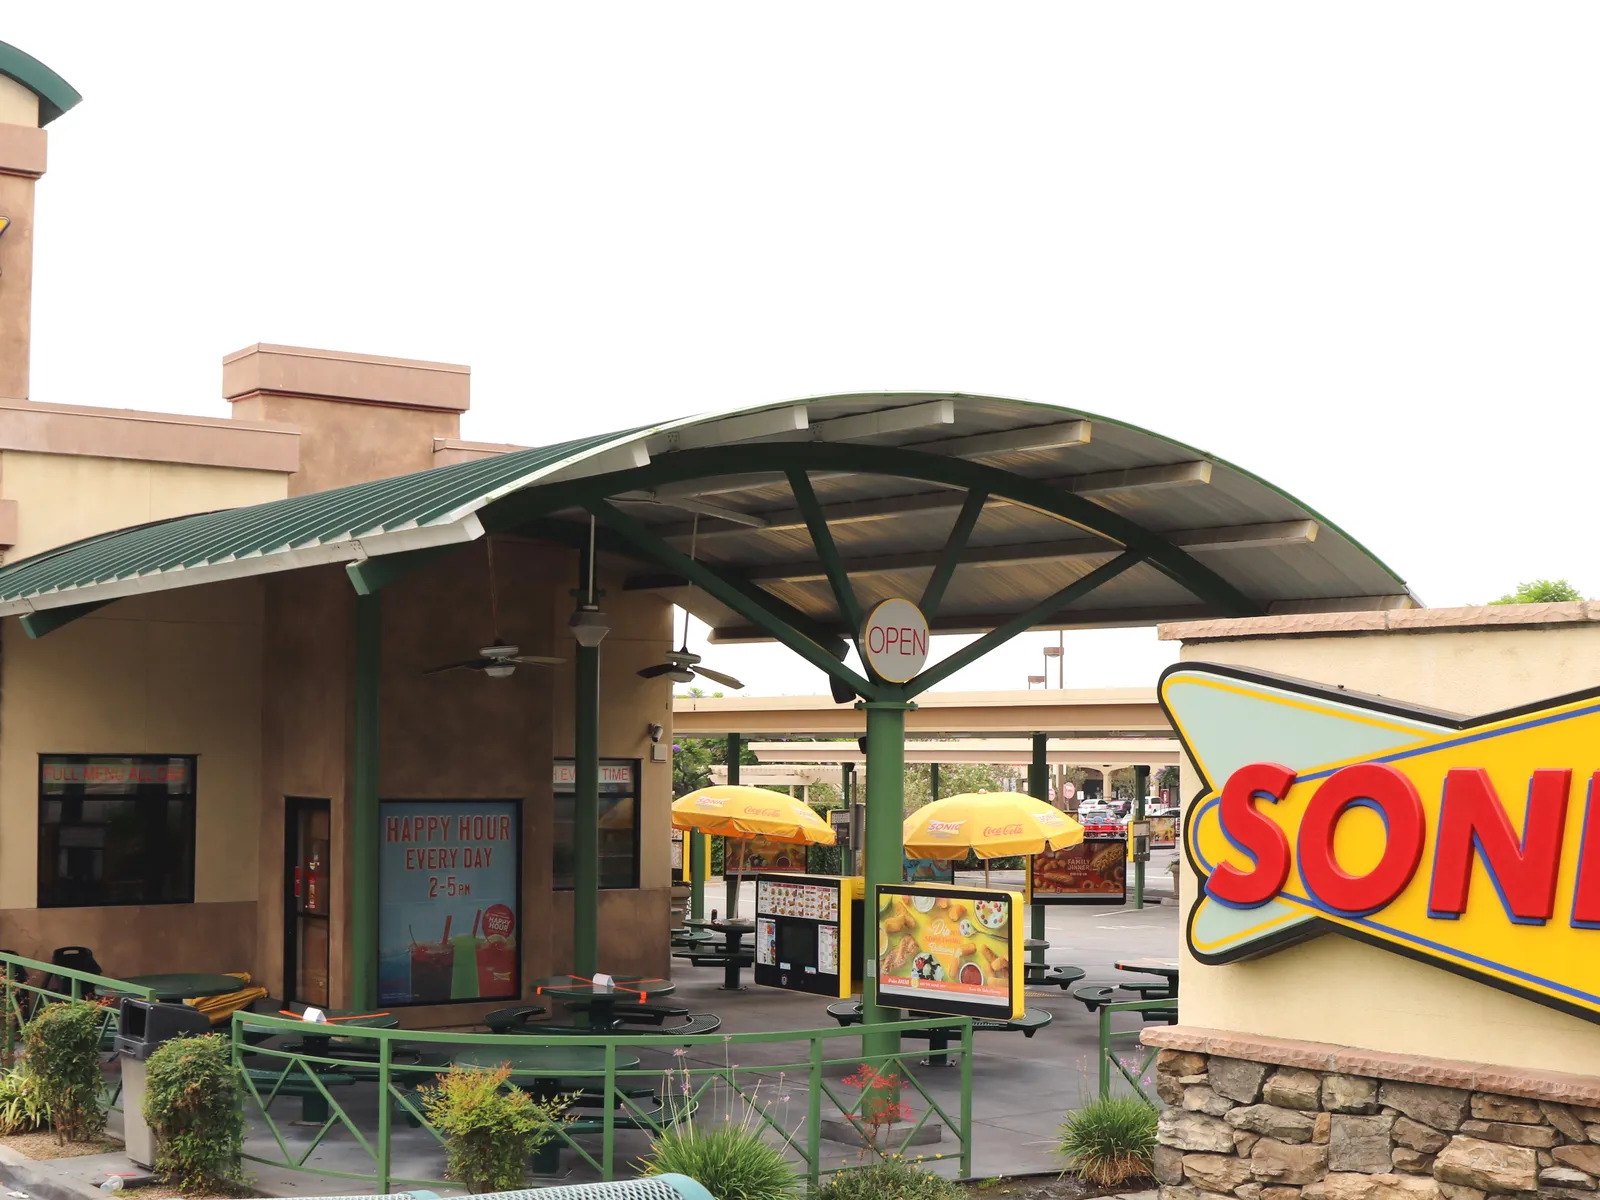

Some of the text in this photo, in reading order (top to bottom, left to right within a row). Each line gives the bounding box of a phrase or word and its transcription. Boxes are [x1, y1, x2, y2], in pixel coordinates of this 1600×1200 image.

[868, 626, 926, 656] OPEN
[43, 765, 187, 781] FULL MENU ALL DAY
[385, 814, 512, 842] HAPPY HOUR
[928, 823, 963, 831] SONIC
[405, 846, 493, 870] EVERY DAY
[428, 875, 471, 898] 2-5 PM
[488, 916, 512, 925] HAPPY
[488, 922, 509, 932] HOUR
